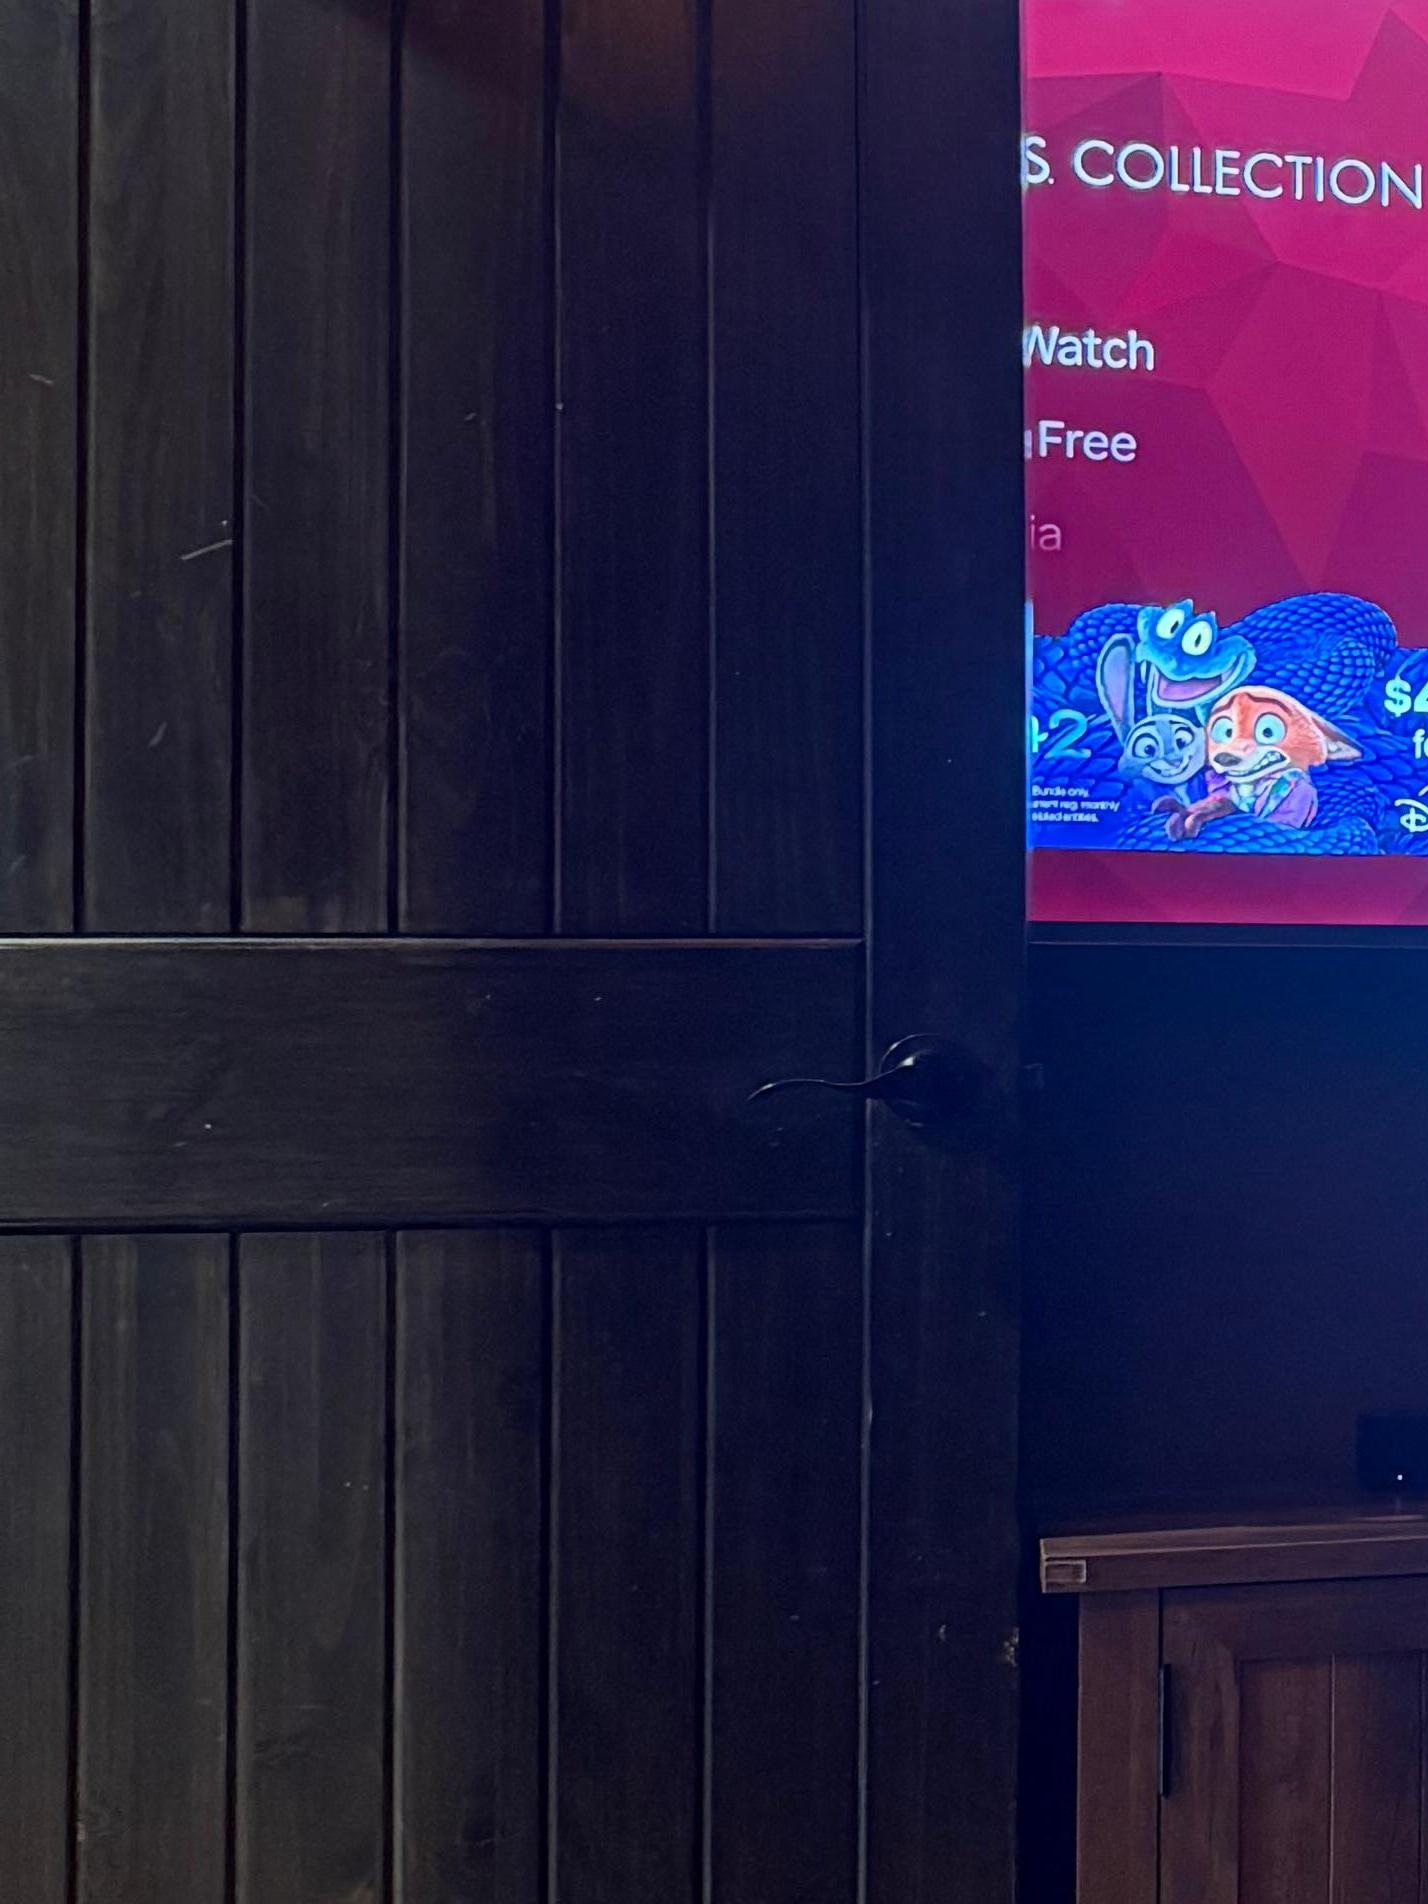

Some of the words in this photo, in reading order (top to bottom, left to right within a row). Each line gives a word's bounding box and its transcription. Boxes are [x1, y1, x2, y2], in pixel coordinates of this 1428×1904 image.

[1072, 138, 1424, 209] COLLECTION
[1021, 324, 1155, 372] Watch
[1037, 419, 1138, 463] Free
